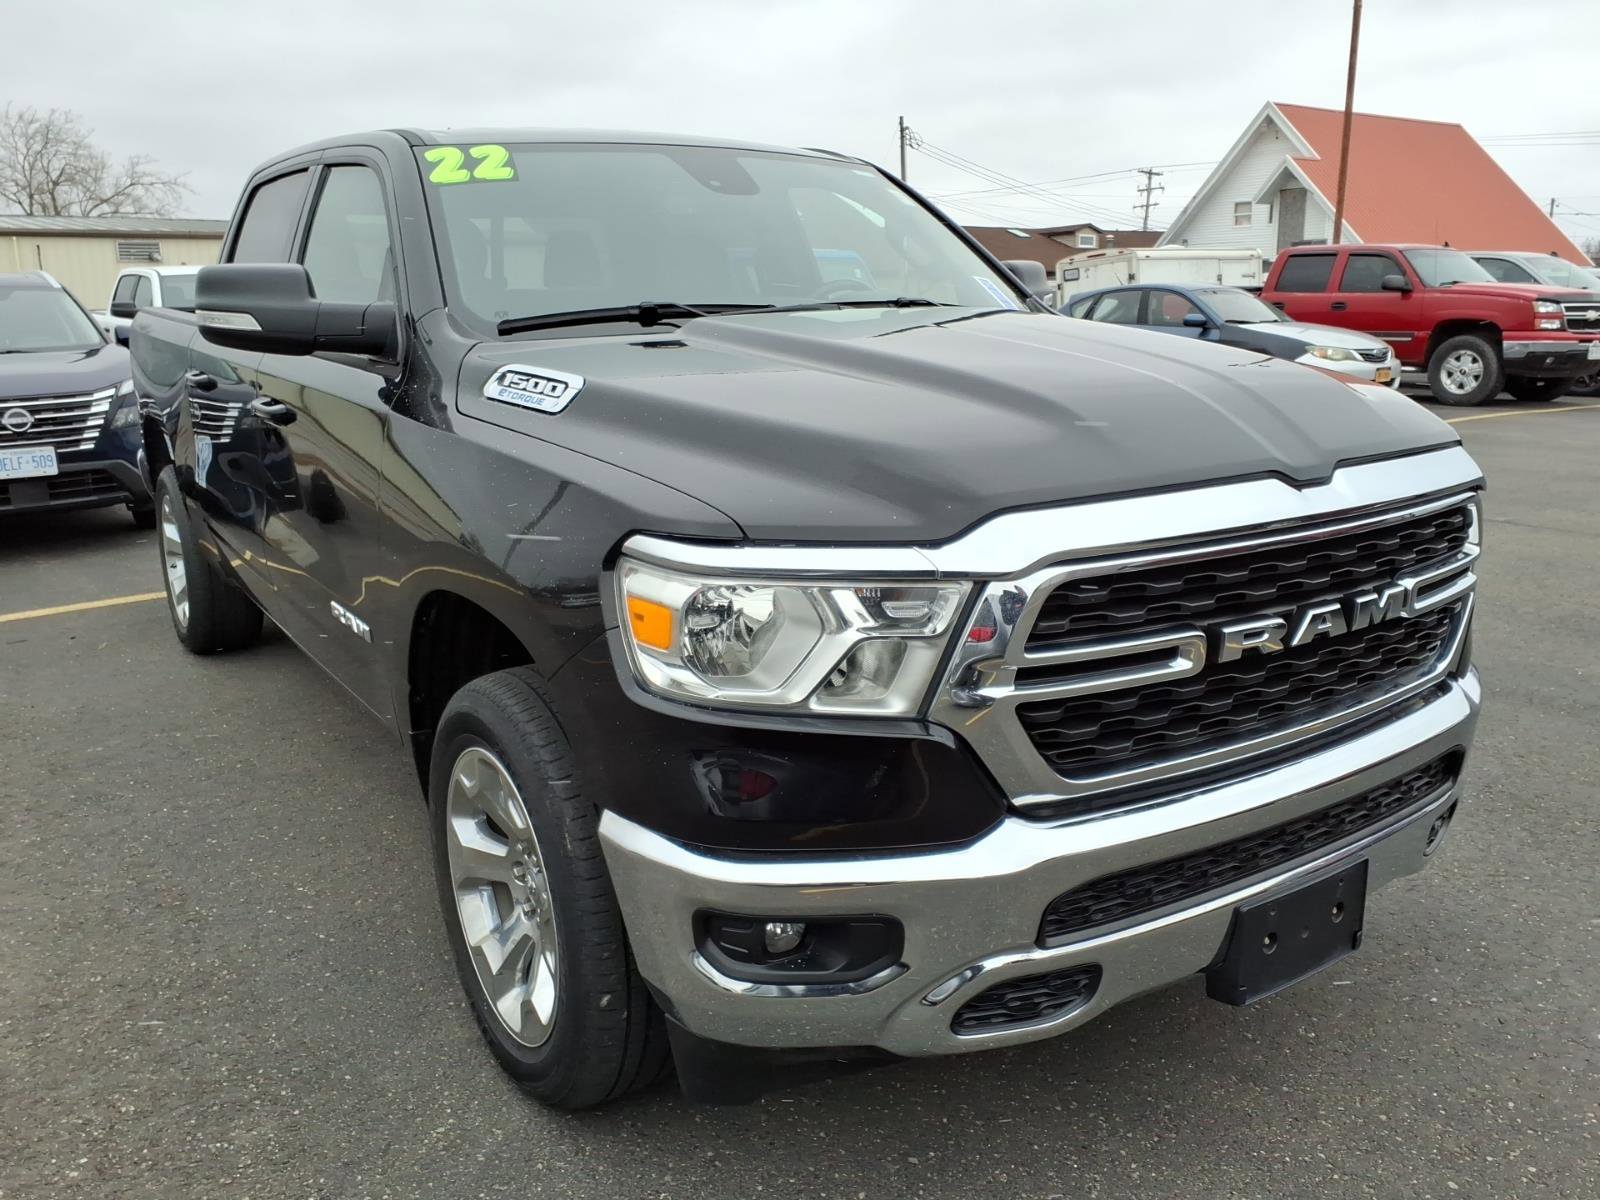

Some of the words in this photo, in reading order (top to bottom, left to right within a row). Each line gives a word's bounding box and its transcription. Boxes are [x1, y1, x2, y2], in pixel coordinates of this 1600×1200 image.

[424, 144, 514, 184] 22
[503, 373, 567, 398] 1500
[31, 454, 54, 469] 509
[330, 600, 371, 643] RAM
[1218, 585, 1405, 664] RAM
